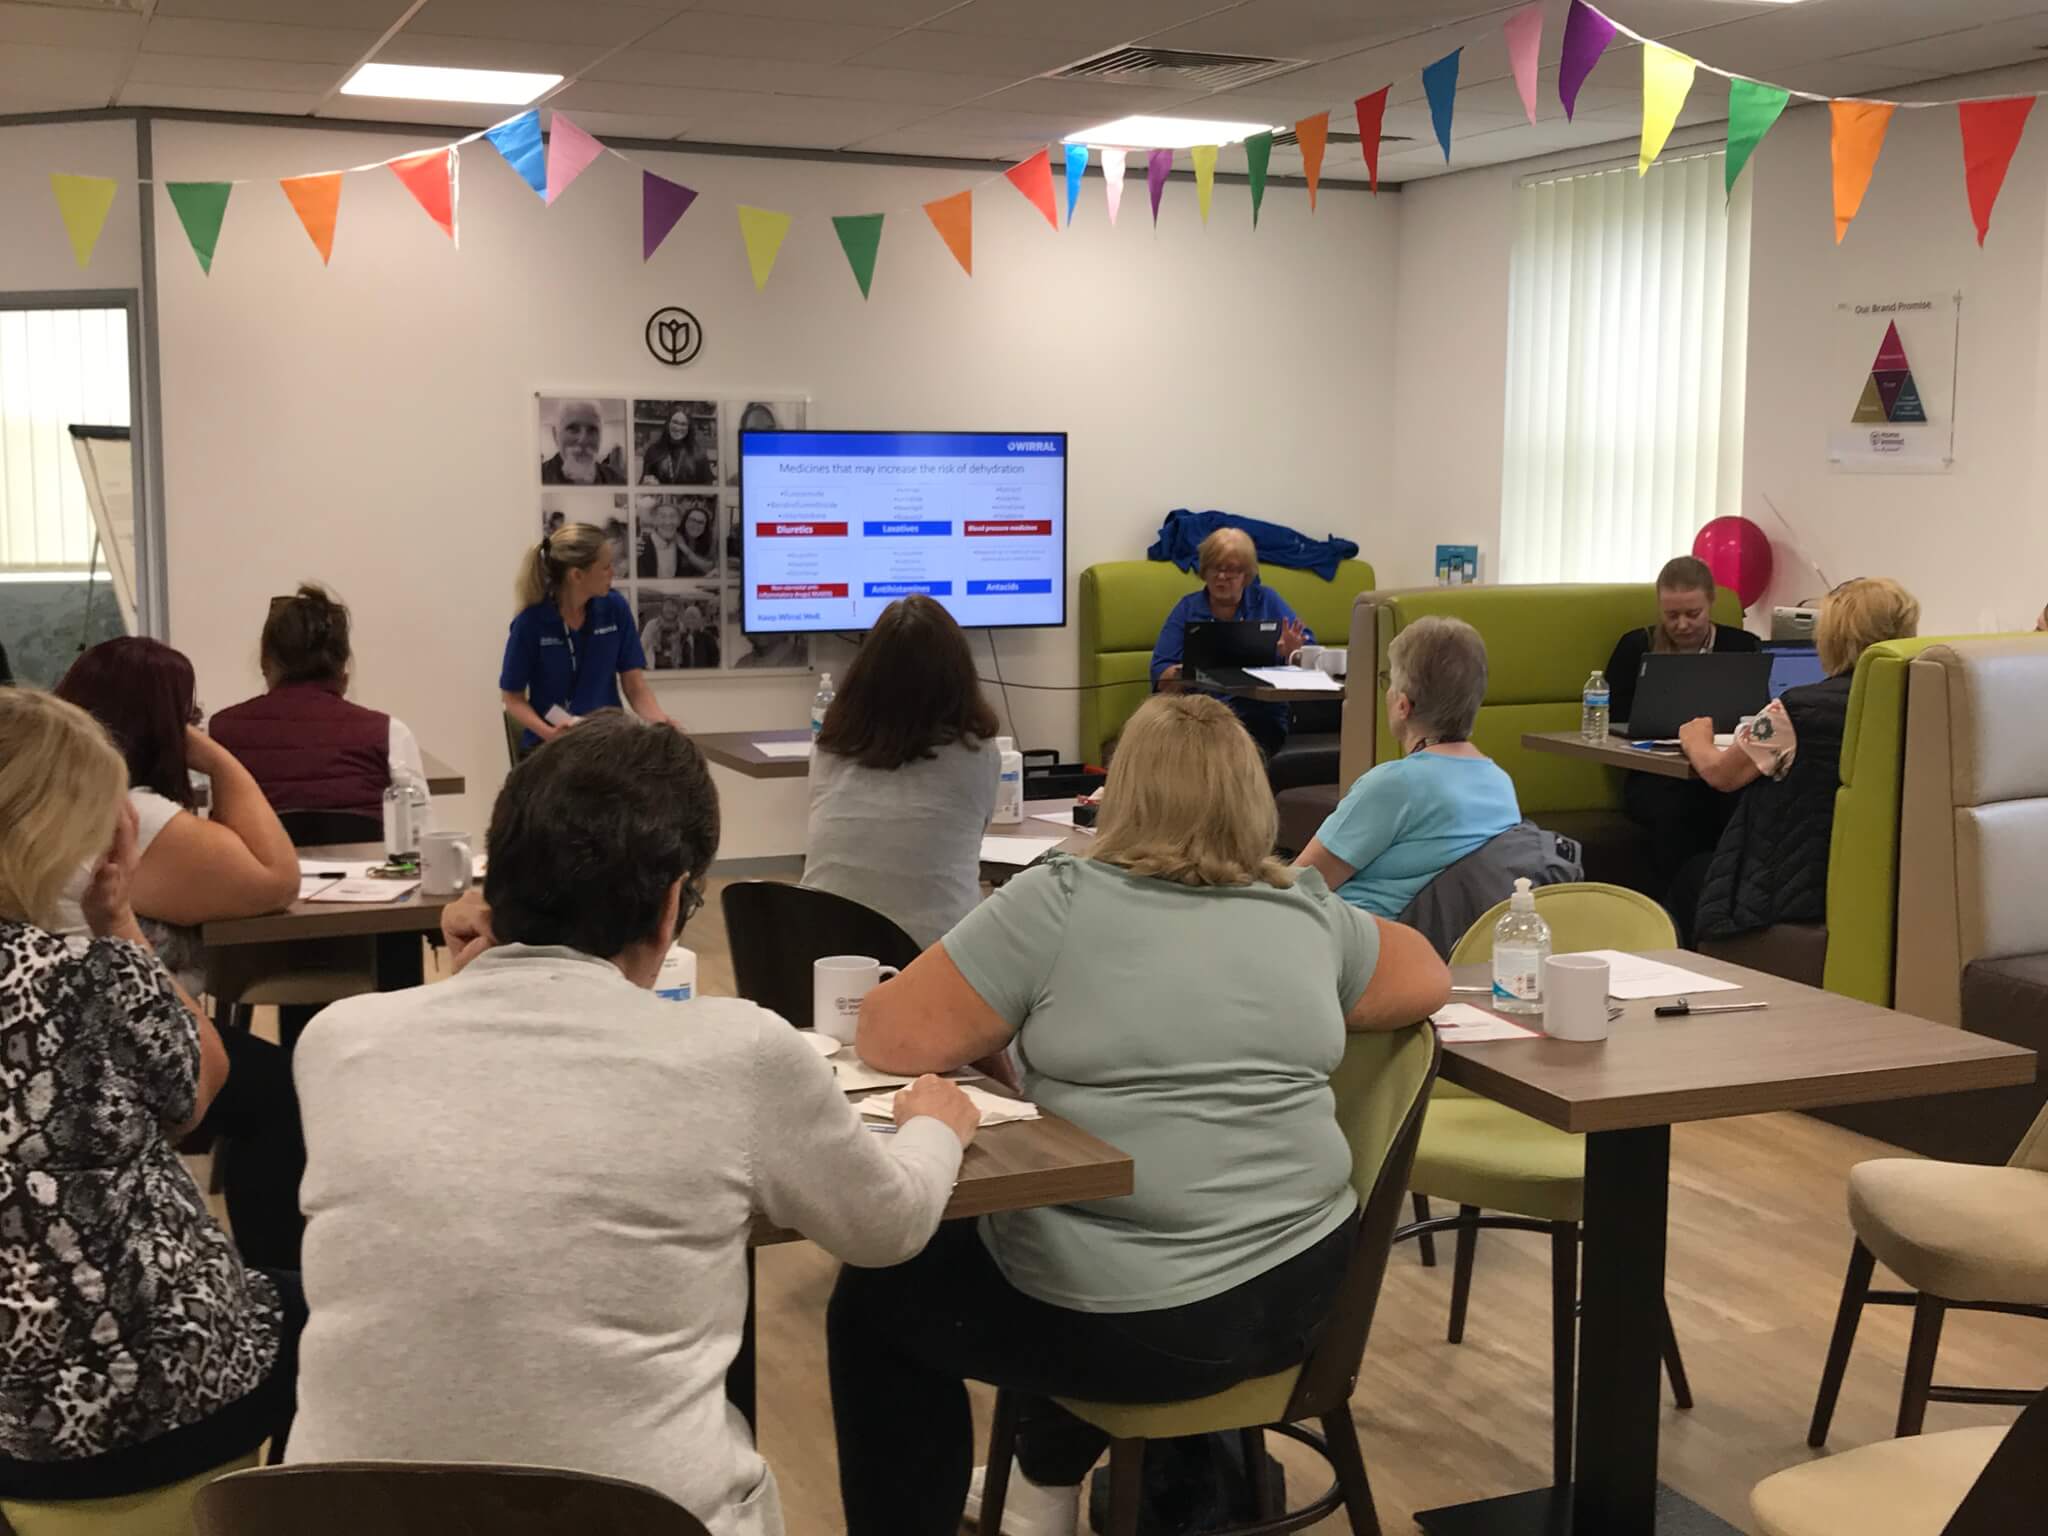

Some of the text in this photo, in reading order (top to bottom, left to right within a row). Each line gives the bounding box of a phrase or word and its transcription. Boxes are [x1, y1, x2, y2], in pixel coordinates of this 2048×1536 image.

[1855, 301, 1932, 314] Our Brand Promise
[1016, 441, 1057, 452] WIRRAL
[779, 462, 1025, 475] Medicines that may increase the risk of dehydration
[776, 524, 814, 535] Diuretics
[882, 524, 920, 534] Laxatives
[871, 585, 930, 594] Antihistamines
[986, 582, 1019, 592] Antacids
